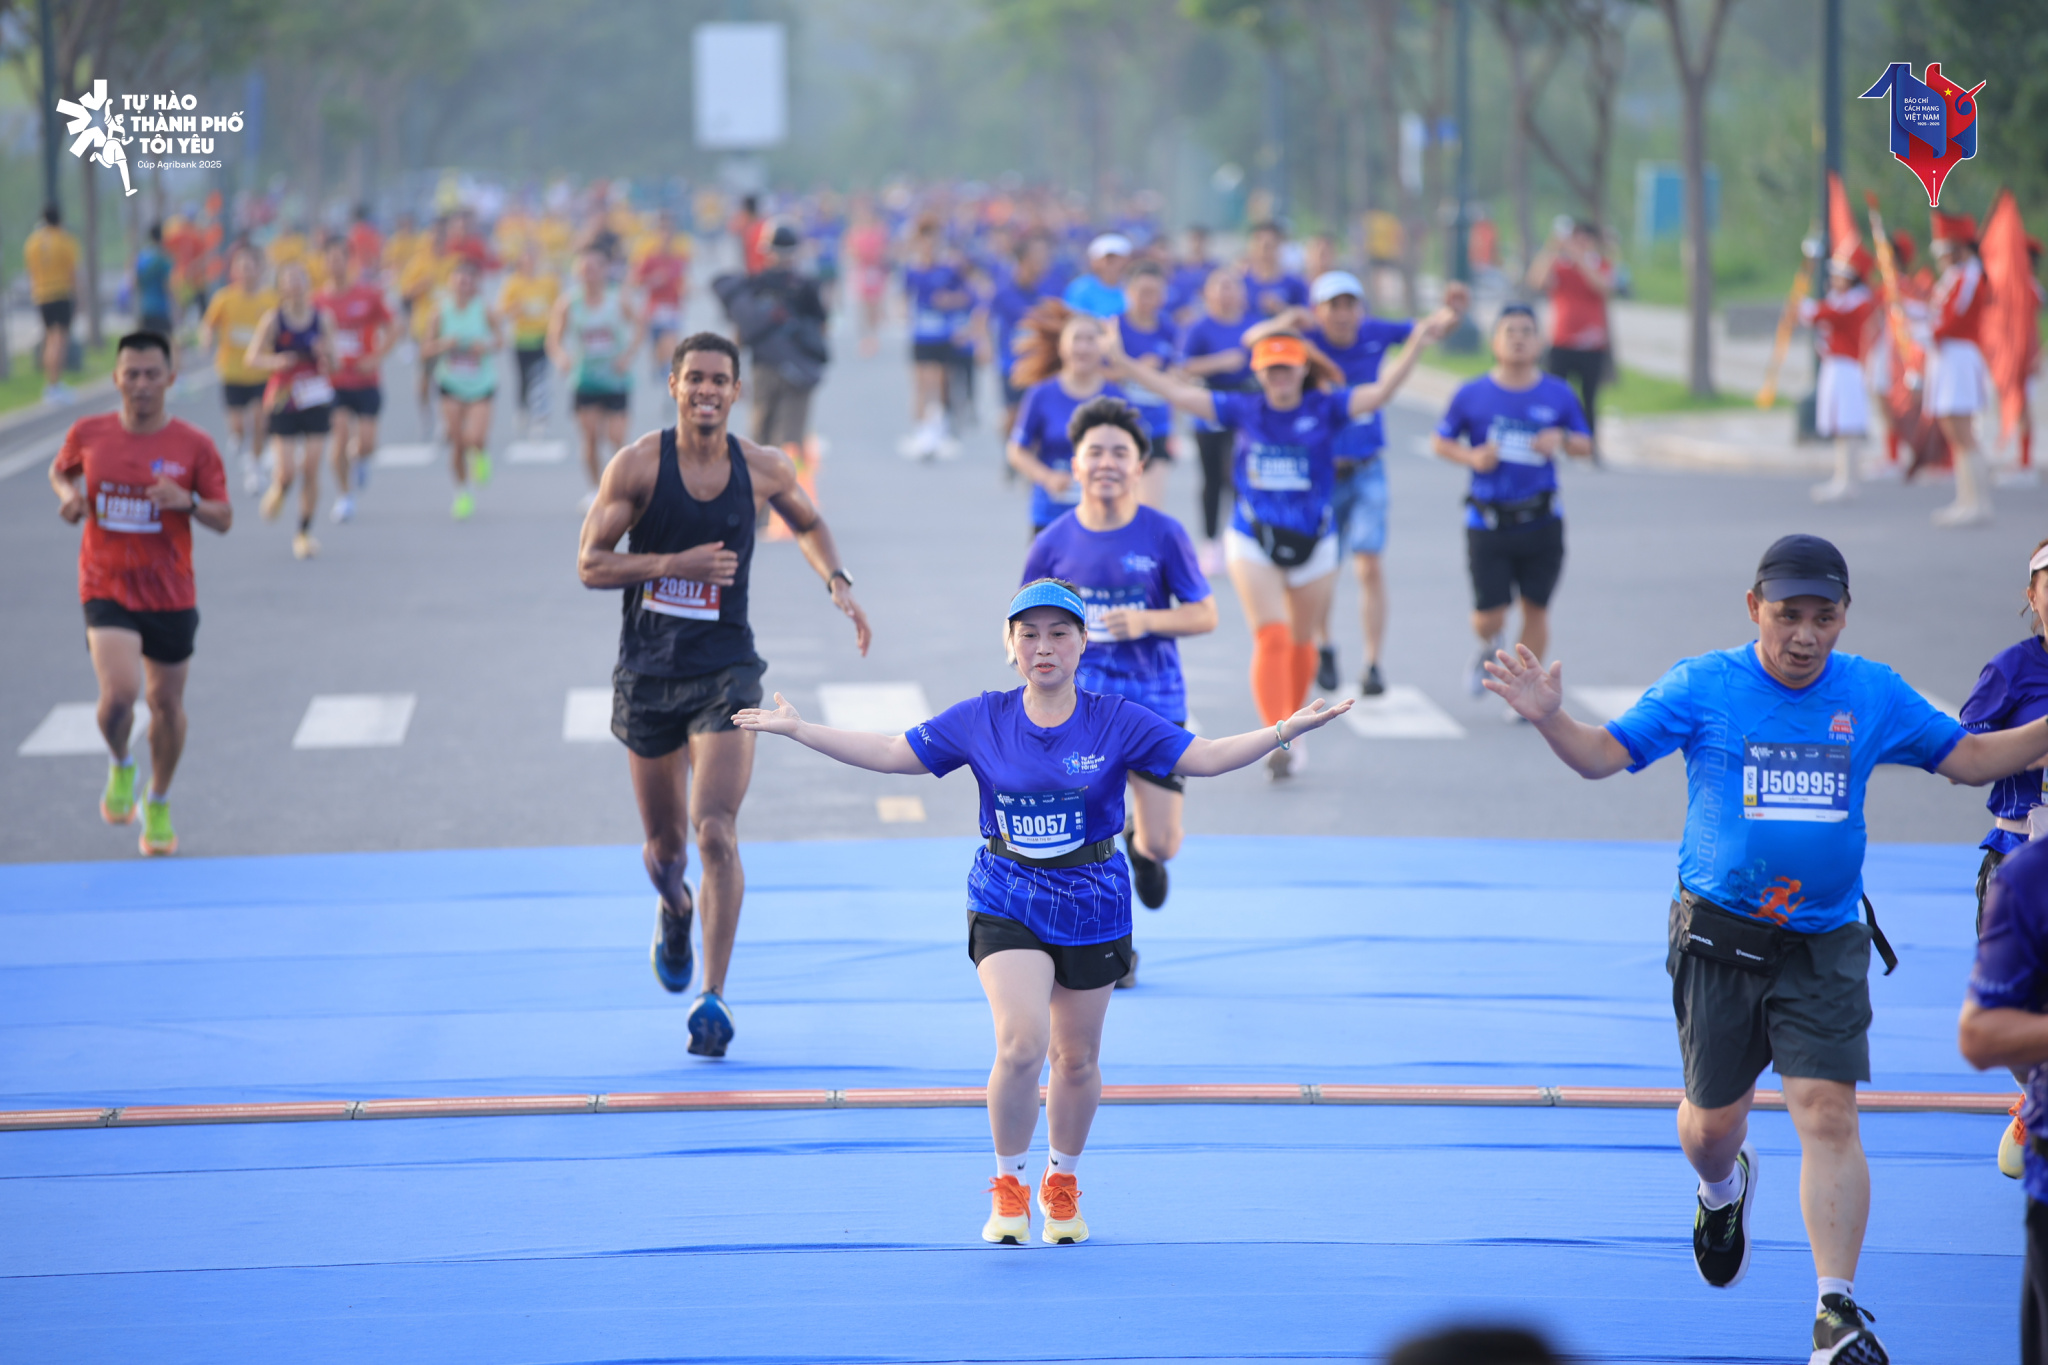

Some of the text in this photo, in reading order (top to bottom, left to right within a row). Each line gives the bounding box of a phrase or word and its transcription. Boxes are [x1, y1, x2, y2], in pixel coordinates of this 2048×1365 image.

[658, 576, 704, 599] 20817
[1760, 769, 1836, 796] J50995
[1012, 813, 1067, 836] 50057
